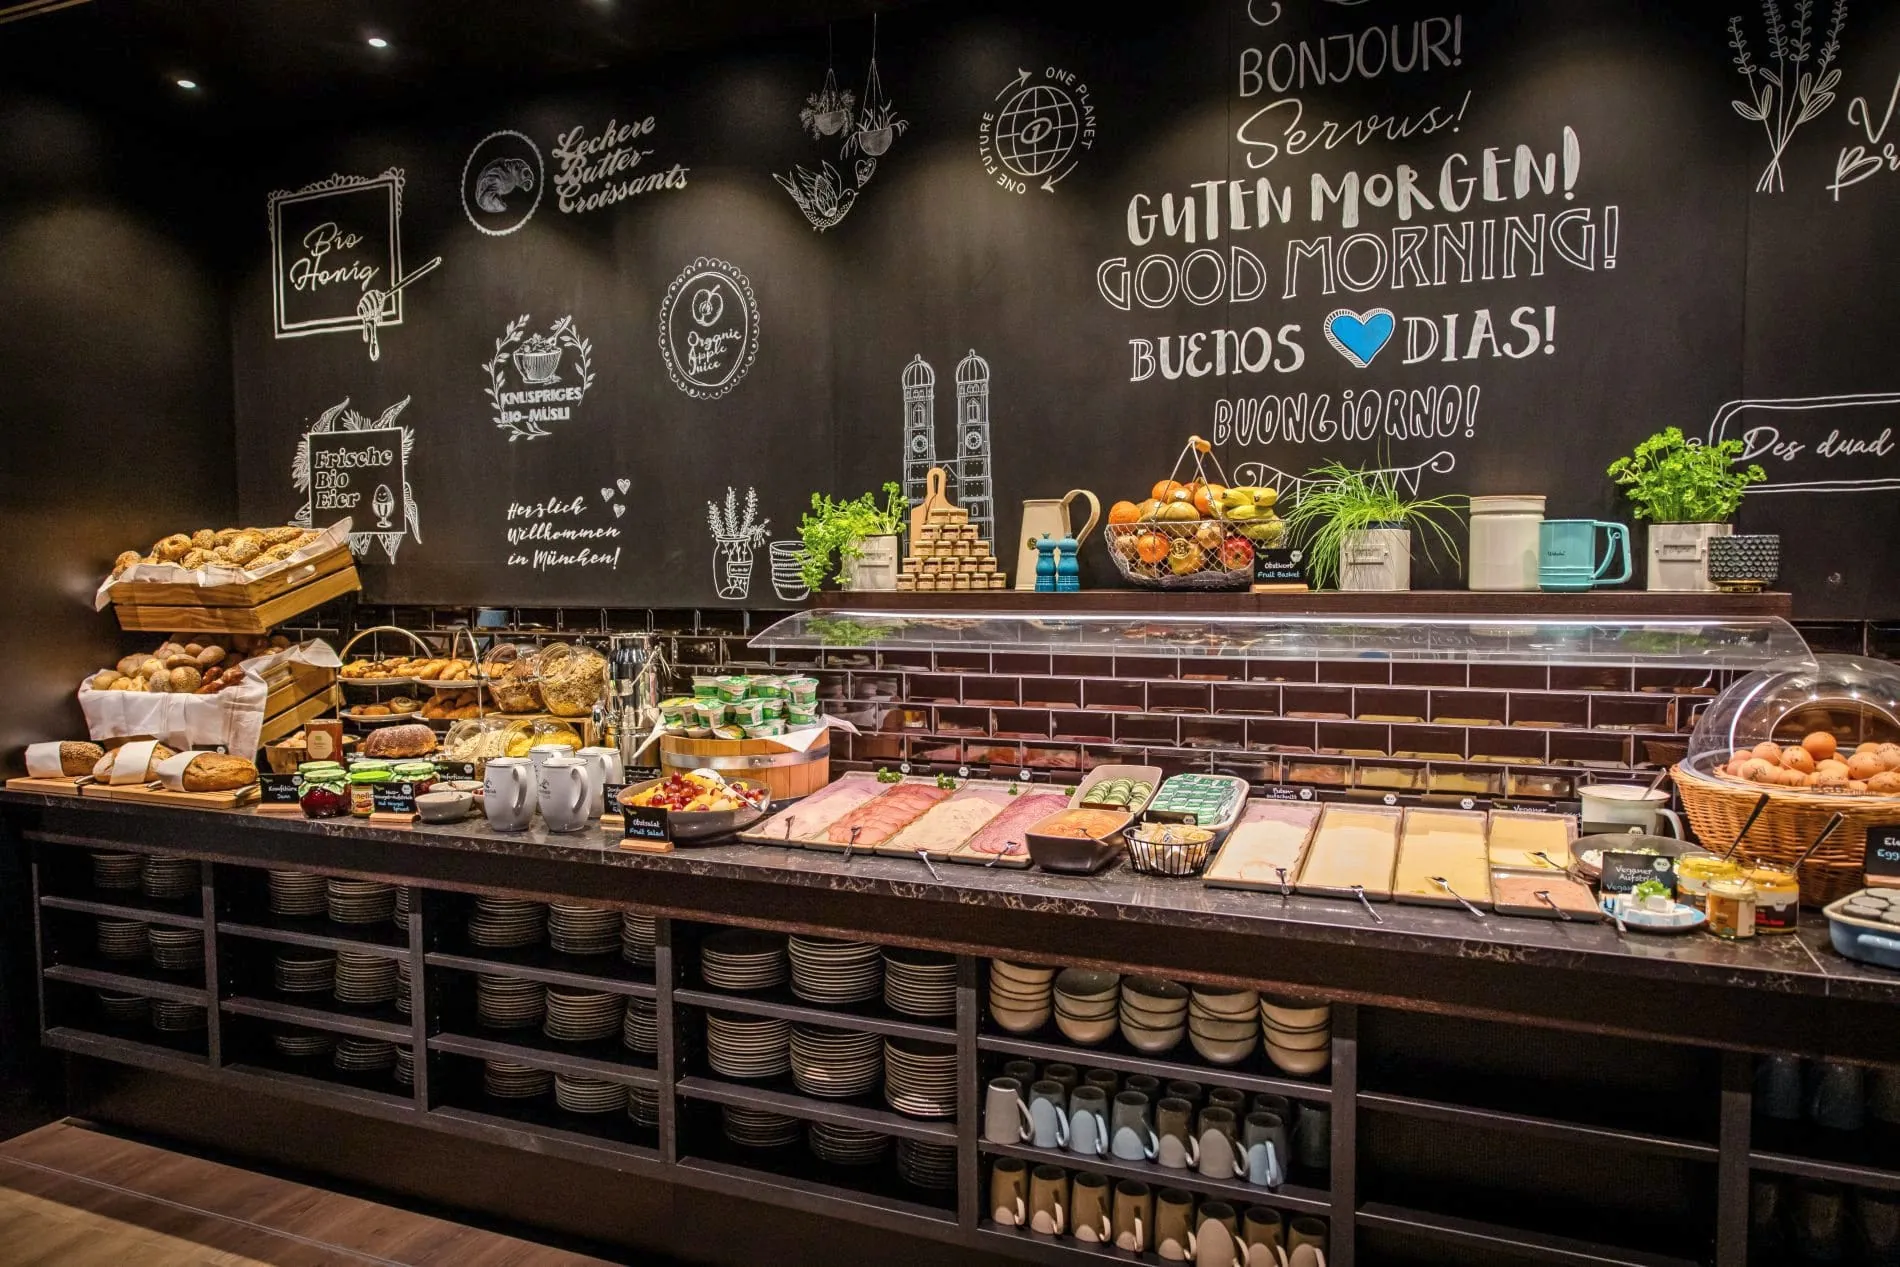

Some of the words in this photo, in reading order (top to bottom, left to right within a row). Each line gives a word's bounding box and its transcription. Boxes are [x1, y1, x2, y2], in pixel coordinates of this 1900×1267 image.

[1239, 14, 1463, 97] BONJOUR!
[1045, 66, 1076, 86] ONE
[1075, 83, 1096, 150] PLANET
[552, 115, 656, 158] Leckere
[1236, 89, 1472, 169] Servus!
[979, 111, 998, 175] FUTURE
[556, 163, 690, 213] Croissants
[996, 173, 1026, 194] ONE
[1127, 176, 1292, 246] GUTEN
[1311, 125, 1581, 229] MORGEN!
[303, 222, 363, 257] Bio
[1097, 245, 1267, 311] GOOD
[1282, 204, 1619, 300] MORNING!
[290, 253, 380, 291] Honig
[688, 328, 742, 351] Organic
[1129, 323, 1305, 383] BUENOS
[1402, 306, 1556, 365] DIAS!
[688, 345, 727, 364] Apple
[688, 360, 720, 376] Juice
[500, 387, 582, 405] KNUSPRIGES
[501, 406, 570, 422] BIO-MÜSLI
[1742, 426, 1804, 461] Des
[1816, 429, 1895, 457] duad
[314, 446, 393, 468] Frische
[315, 468, 349, 488] Bio
[315, 488, 360, 509] Eier
[507, 496, 588, 520] Herzlich
[507, 522, 621, 545] Willkommen
[507, 553, 529, 565] in
[533, 547, 621, 572] München!
[1615, 865, 1653, 876] Veganer
